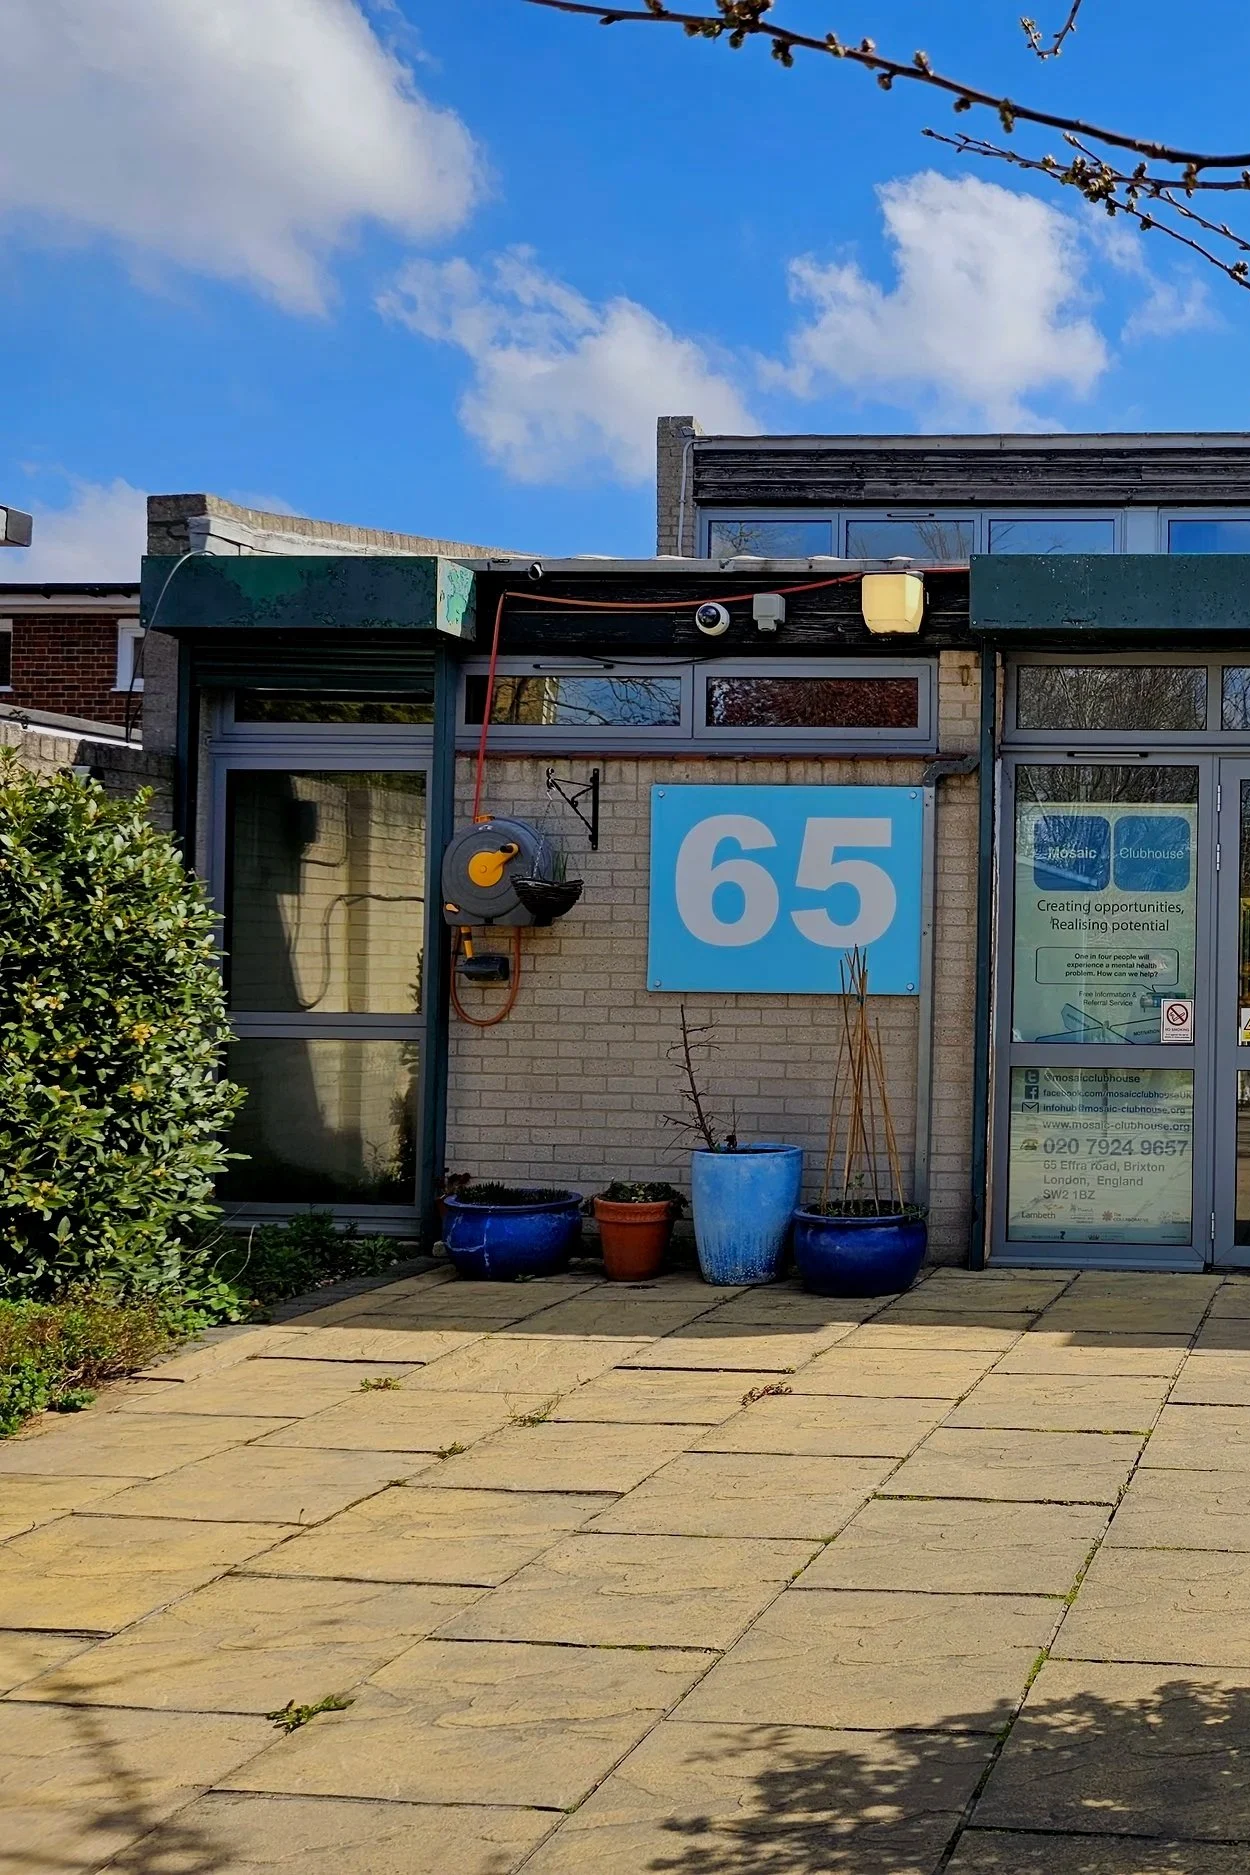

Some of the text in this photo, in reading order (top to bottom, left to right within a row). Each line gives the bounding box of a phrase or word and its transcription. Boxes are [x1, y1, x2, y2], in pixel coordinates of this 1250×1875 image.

[1048, 846, 1184, 859] Mosaic Clubhouse
[675, 814, 897, 949] 65
[1037, 900, 1185, 915] Creating opportunities,
[1051, 919, 1169, 933] Realising potential
[1074, 953, 1089, 961] One
[1113, 953, 1137, 962] people
[1138, 953, 1150, 961] will
[1066, 963, 1104, 971] experience
[1136, 962, 1158, 970] health
[1065, 970, 1096, 979] problem.
[1139, 971, 1159, 979] help?
[1078, 990, 1093, 998] Fee
[1109, 999, 1133, 1007] Service
[1044, 1073, 1141, 1083] @mosaicclubhouse
[1042, 1120, 1190, 1132] www.mosaic-clubhouse.org
[1043, 1138, 1189, 1156] 020 7924 9657
[1043, 1160, 1165, 1172] 65 Effra road, Brixton
[1043, 1175, 1143, 1188] London, England
[1043, 1189, 1096, 1200] SW2 1BZ
[1021, 1211, 1056, 1219] Lambeth
